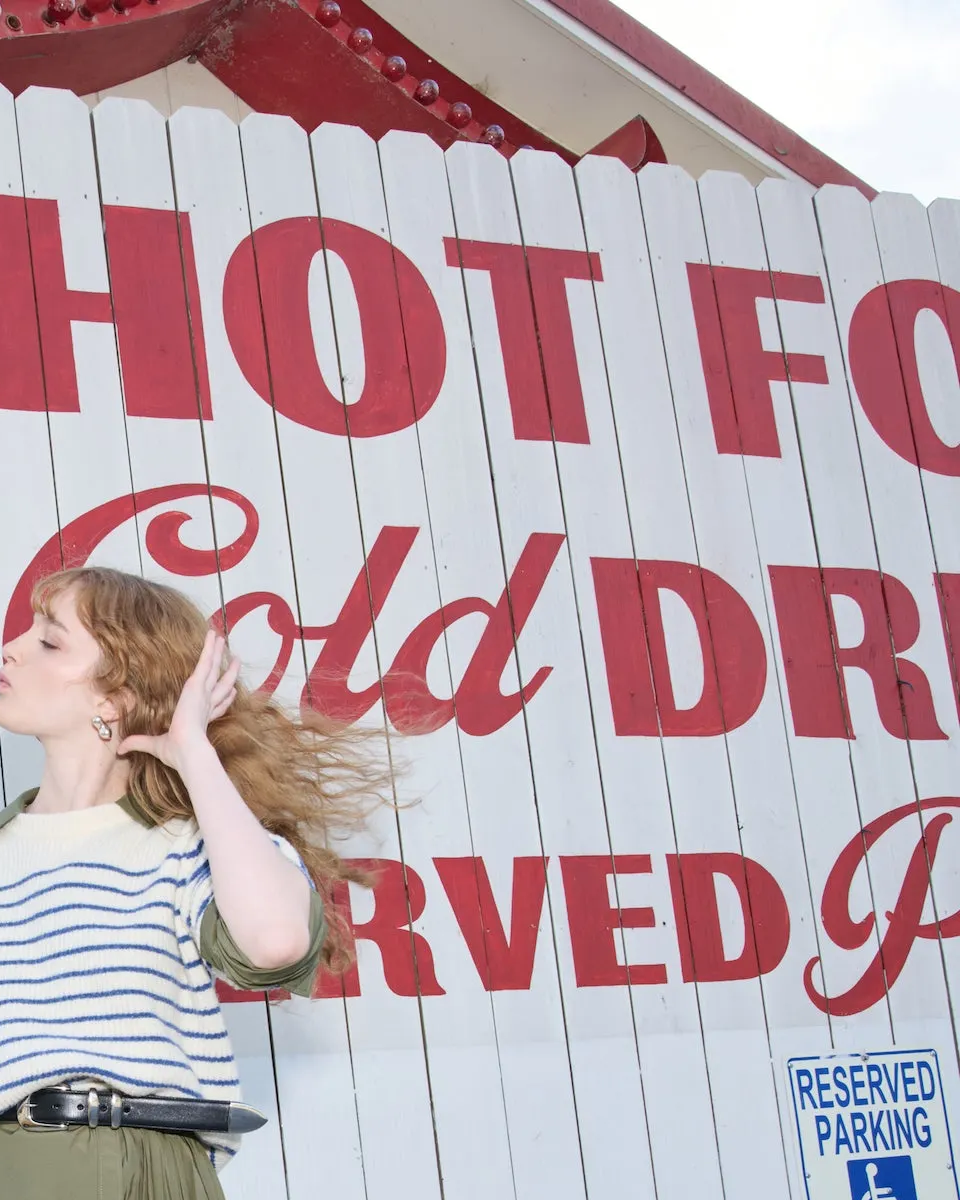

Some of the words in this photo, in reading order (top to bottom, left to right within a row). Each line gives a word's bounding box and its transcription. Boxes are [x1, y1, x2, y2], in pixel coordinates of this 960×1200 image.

[685, 262, 960, 478] FO
[215, 852, 791, 1003] RVED
[796, 1060, 936, 1110] RESERVED
[815, 1106, 932, 1156] PARKING
